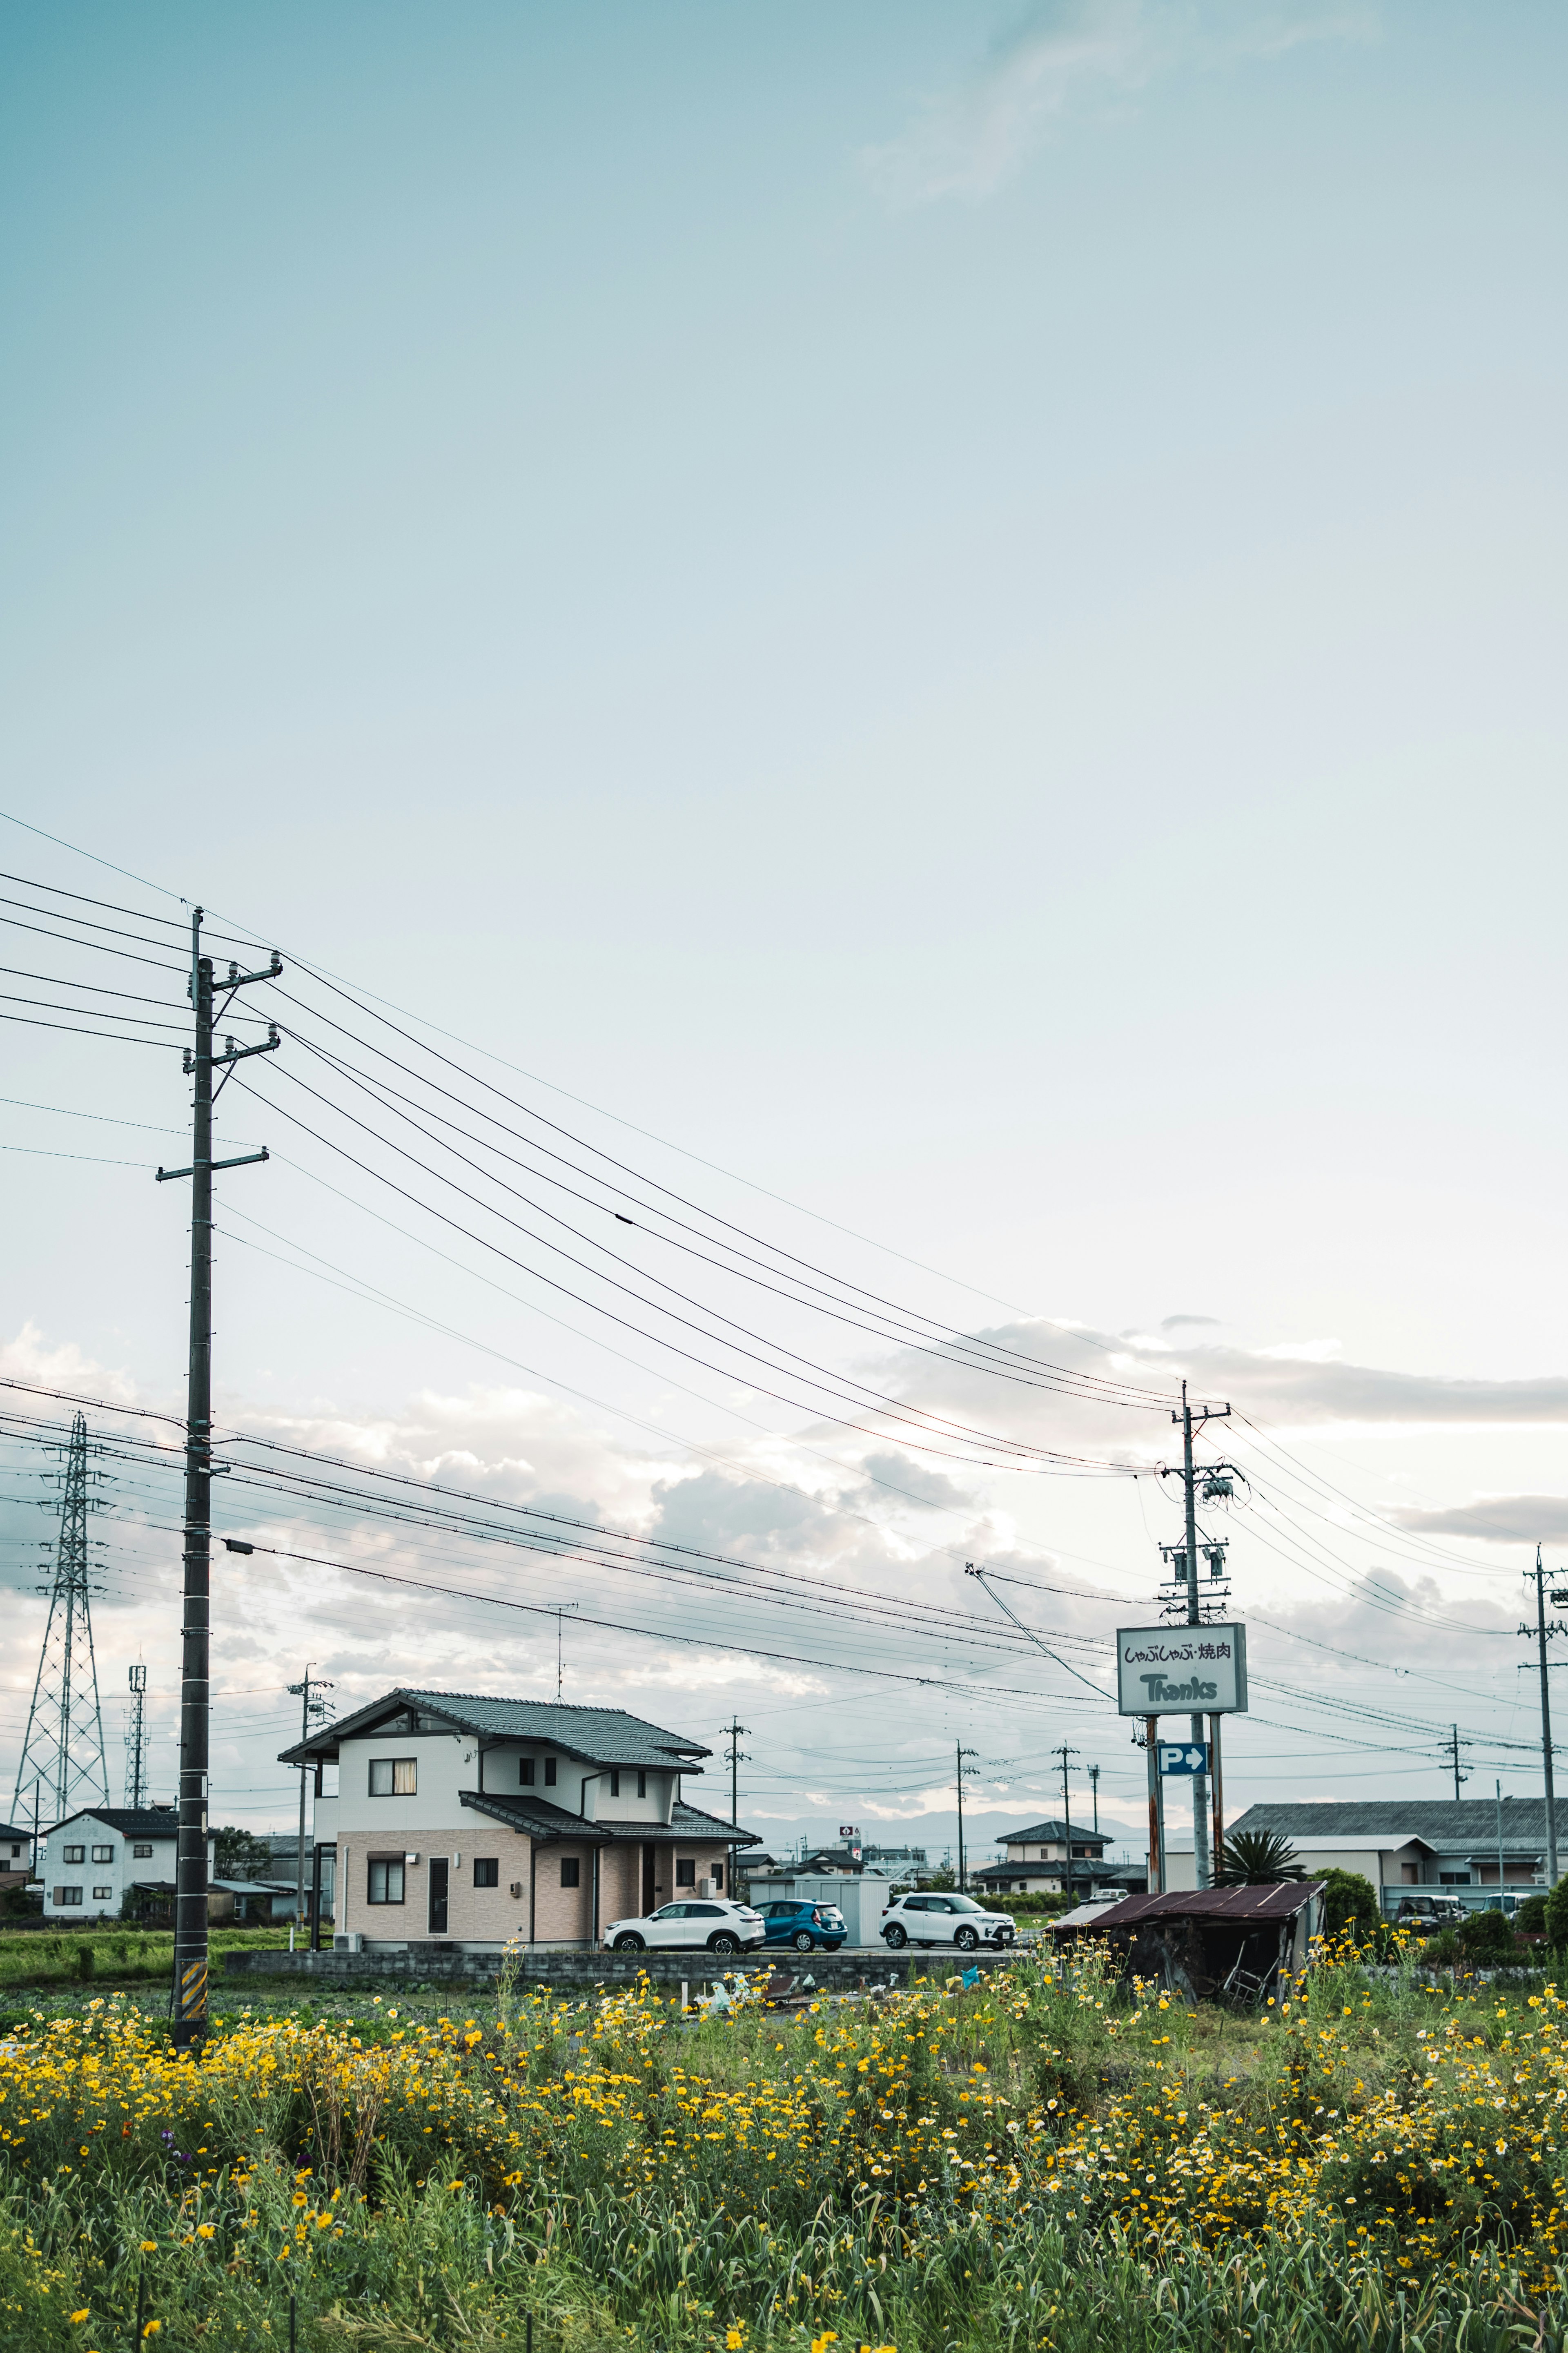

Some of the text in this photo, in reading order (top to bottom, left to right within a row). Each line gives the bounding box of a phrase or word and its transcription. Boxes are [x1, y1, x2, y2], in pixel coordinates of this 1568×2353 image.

[1125, 1642, 1230, 1663] しゃぶしゃぶ・焼肉
[1140, 1674, 1217, 1702] Thanks
[1161, 1748, 1183, 1771] P
